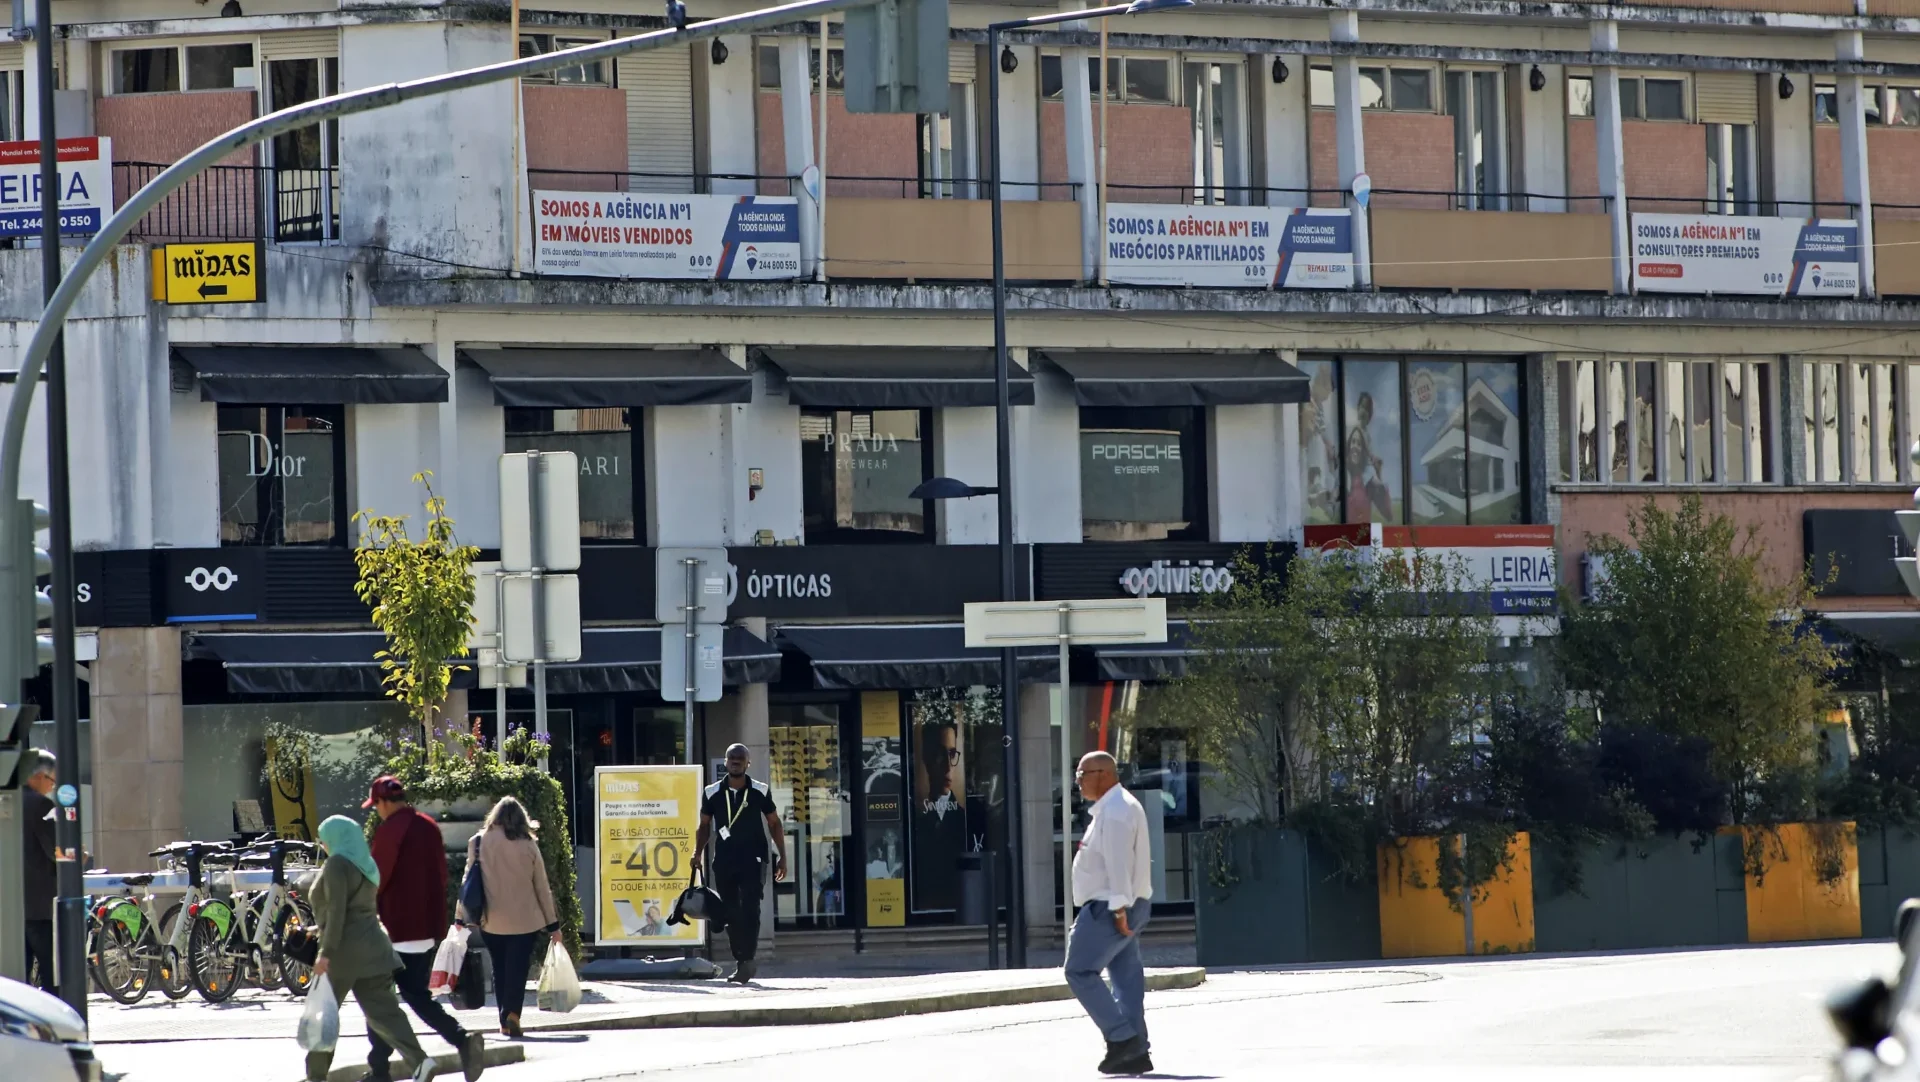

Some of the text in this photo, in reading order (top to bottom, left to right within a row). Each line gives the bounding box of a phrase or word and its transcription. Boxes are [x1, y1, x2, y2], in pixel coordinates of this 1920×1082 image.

[1, 149, 23, 157] Mundial
[541, 199, 590, 218] SOMOS
[593, 200, 603, 218] A
[606, 197, 667, 220] AGÊNCIA
[70, 215, 91, 227] 550
[738, 211, 785, 222] A AGÊNCIA ONDE
[1, 218, 42, 230] Tel. 244
[738, 223, 786, 233] TODOS GANHAM!
[1109, 217, 1155, 235] SOMOS
[1157, 219, 1166, 236] A
[1169, 215, 1227, 237] AGÊNCIA
[1251, 221, 1269, 238] EM
[1292, 224, 1335, 235] A AGÊNCIA ONDE
[541, 220, 693, 246] EM IMÓVEIS VENDIDOS
[1637, 224, 1671, 239] SOMOS
[1673, 228, 1680, 239] A
[1682, 221, 1727, 240] AGÊNCIA
[1747, 228, 1760, 241] EM
[1292, 235, 1336, 245] TODOS GANHAM!
[562, 248, 583, 257] vendas
[623, 250, 639, 259] foram
[639, 250, 665, 260] realizadas
[665, 252, 677, 262] pela
[1109, 238, 1265, 262] NEGÓCIOS PARTILHADOS
[1638, 243, 1760, 260] CONSULTORES PREMIADOS
[558, 259, 581, 269] agência!
[759, 260, 797, 270] 244 800 550
[1307, 264, 1346, 273] RE/MAX LEIRIA
[1823, 279, 1856, 288] 244 800 550
[824, 432, 899, 452] PRADA
[246, 433, 306, 477] Dior
[1092, 444, 1180, 460] PORSCHE
[836, 458, 888, 470] EYEWEAR
[1114, 465, 1160, 474] EYEWEAR
[1491, 556, 1551, 582] LEIRIA
[747, 569, 832, 598] ÓPTICAS
[609, 827, 688, 837] REVISÃO OFICIAL
[611, 881, 689, 892] DO QUE NA MARCA
